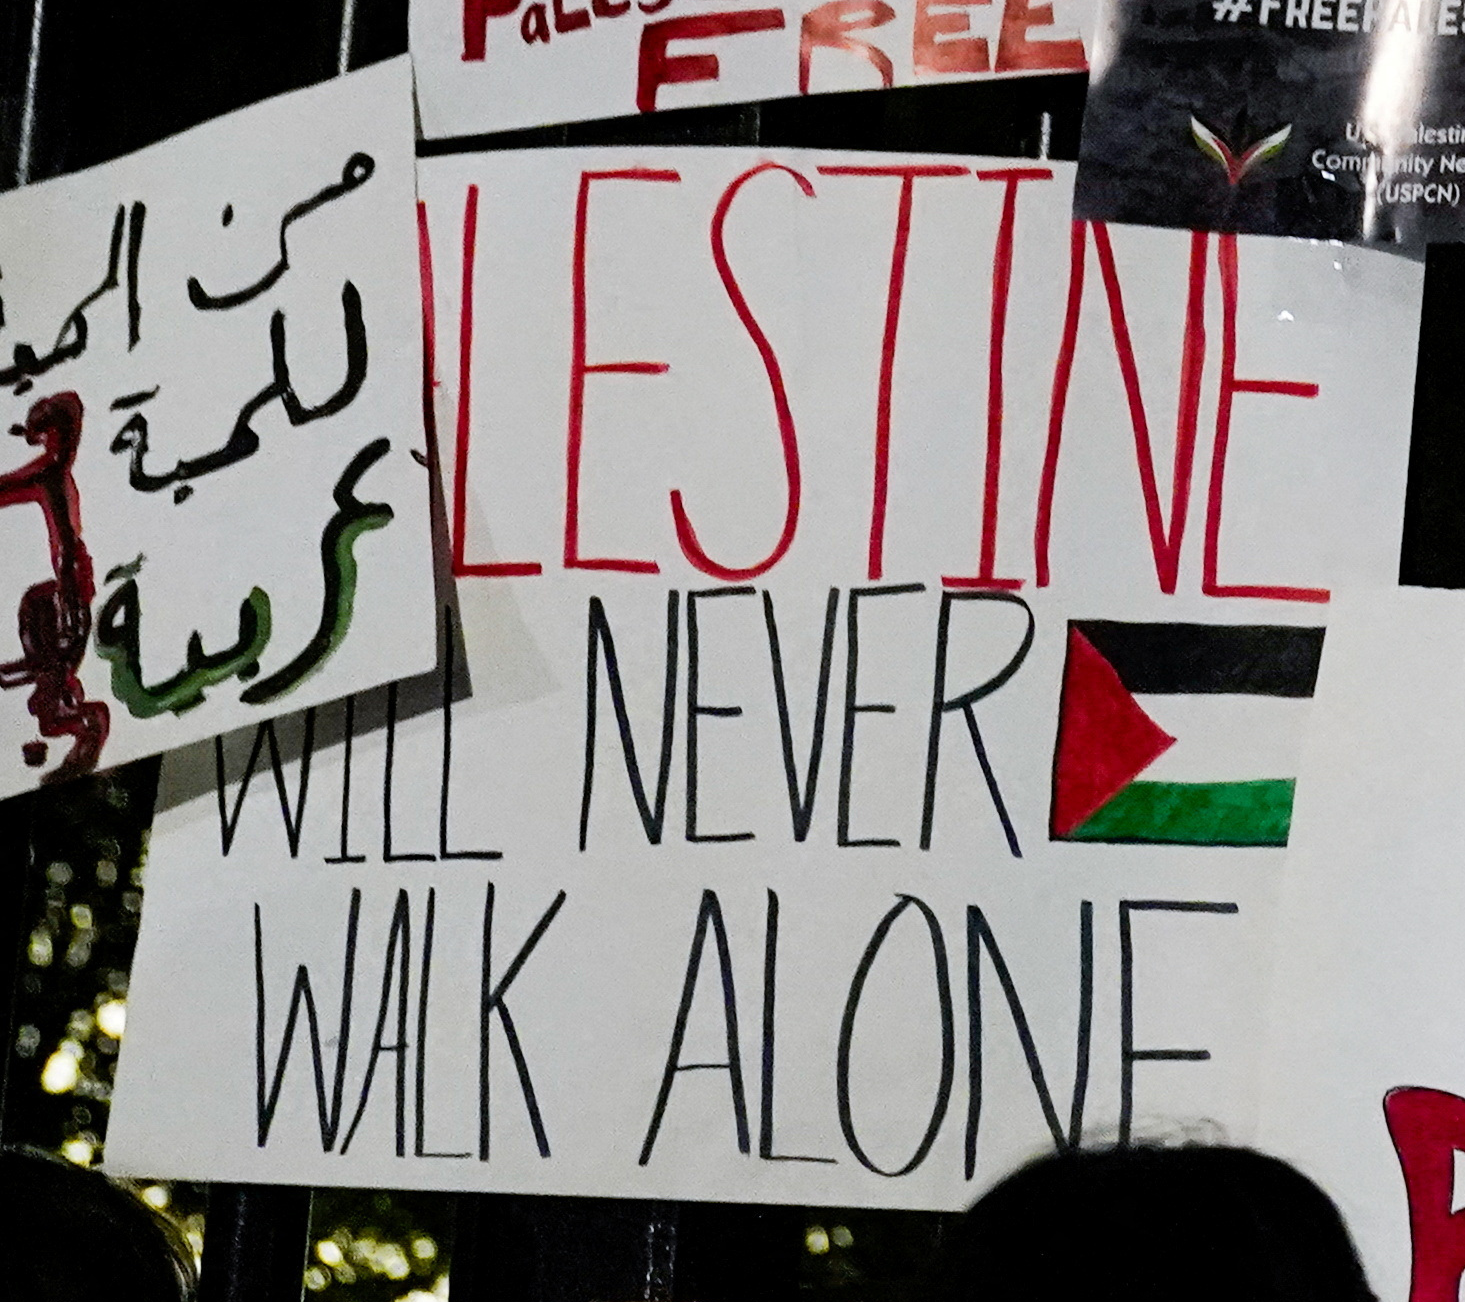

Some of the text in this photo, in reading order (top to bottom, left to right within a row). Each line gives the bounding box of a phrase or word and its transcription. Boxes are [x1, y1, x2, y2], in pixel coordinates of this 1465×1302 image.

[214, 585, 1037, 862] WILL NEVER
[254, 882, 1238, 1179] WALK ALONE
